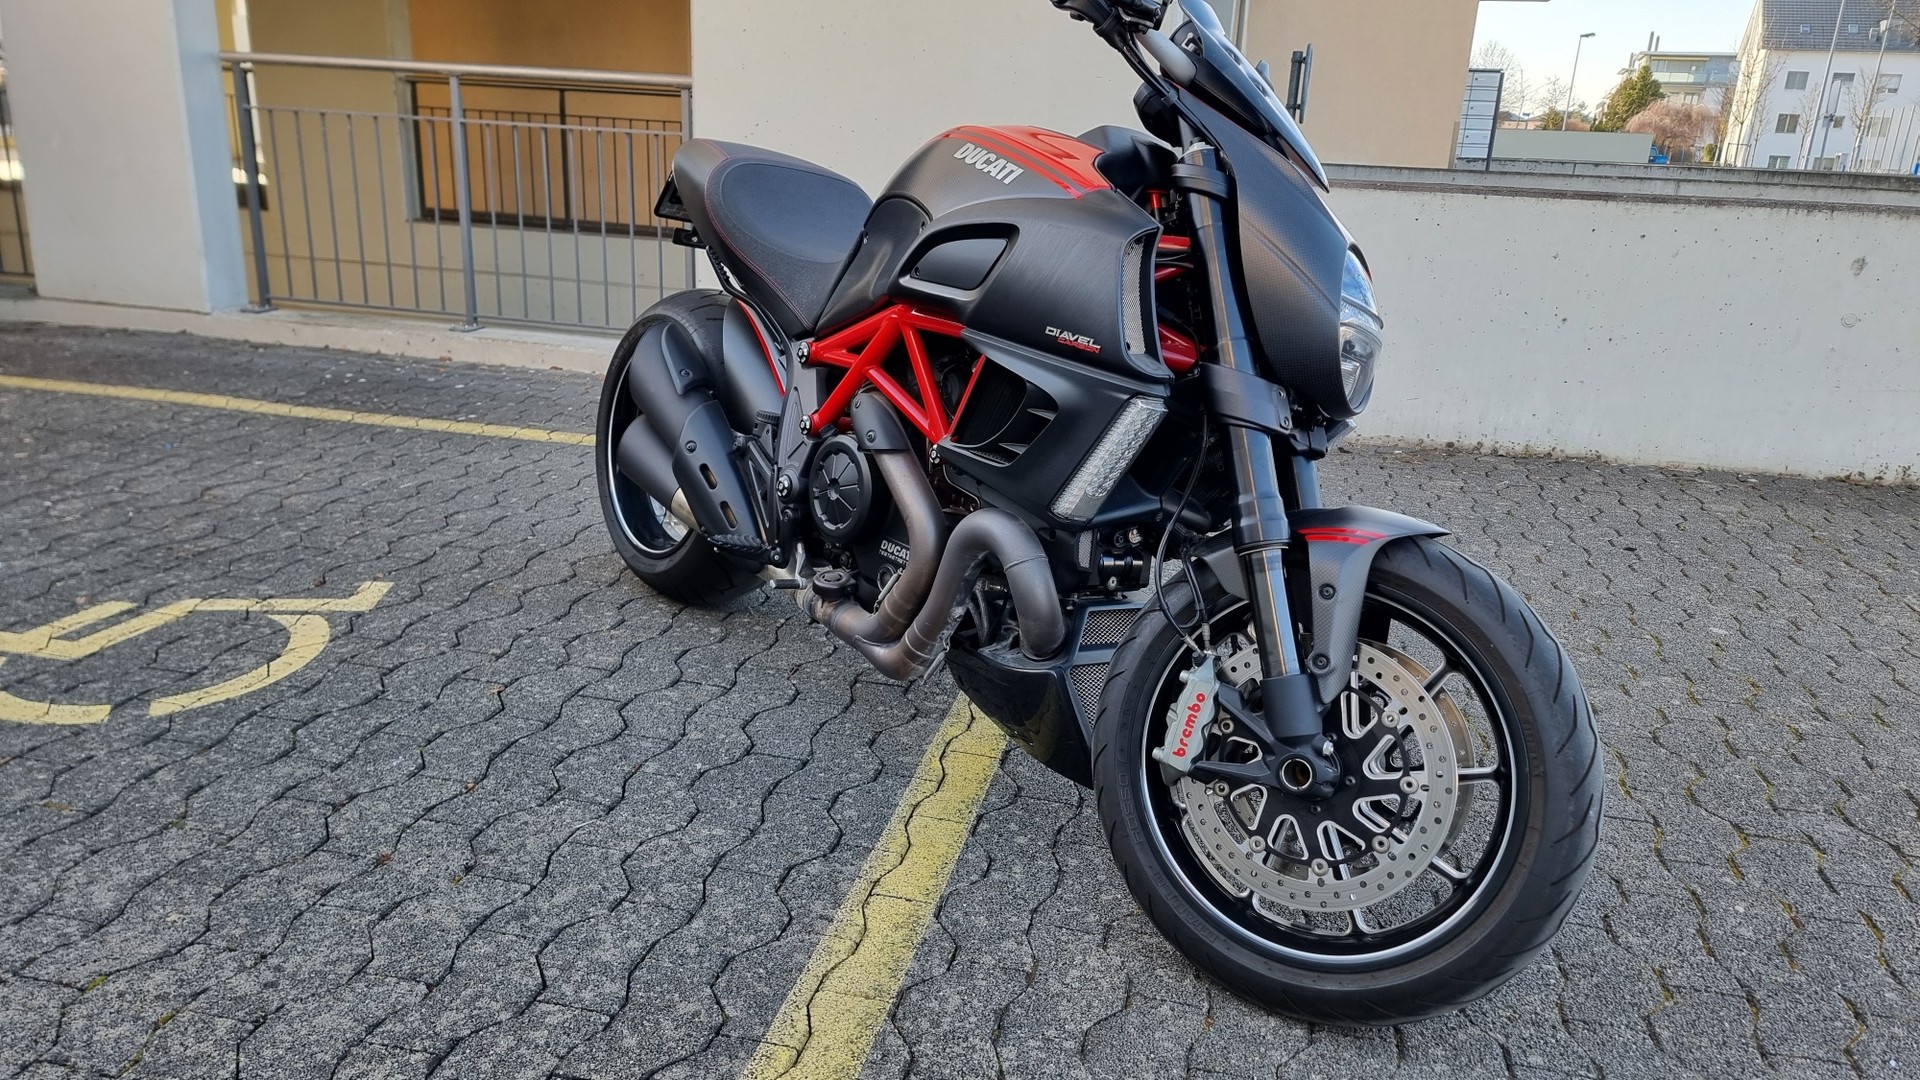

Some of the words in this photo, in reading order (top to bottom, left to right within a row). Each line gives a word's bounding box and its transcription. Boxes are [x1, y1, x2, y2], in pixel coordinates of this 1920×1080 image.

[953, 142, 1025, 185] DUCATI
[1044, 325, 1102, 349] DIAVEL
[880, 539, 910, 561] DUCAT
[1172, 692, 1206, 758] brembo
[1118, 773, 1145, 845] ROSSO
